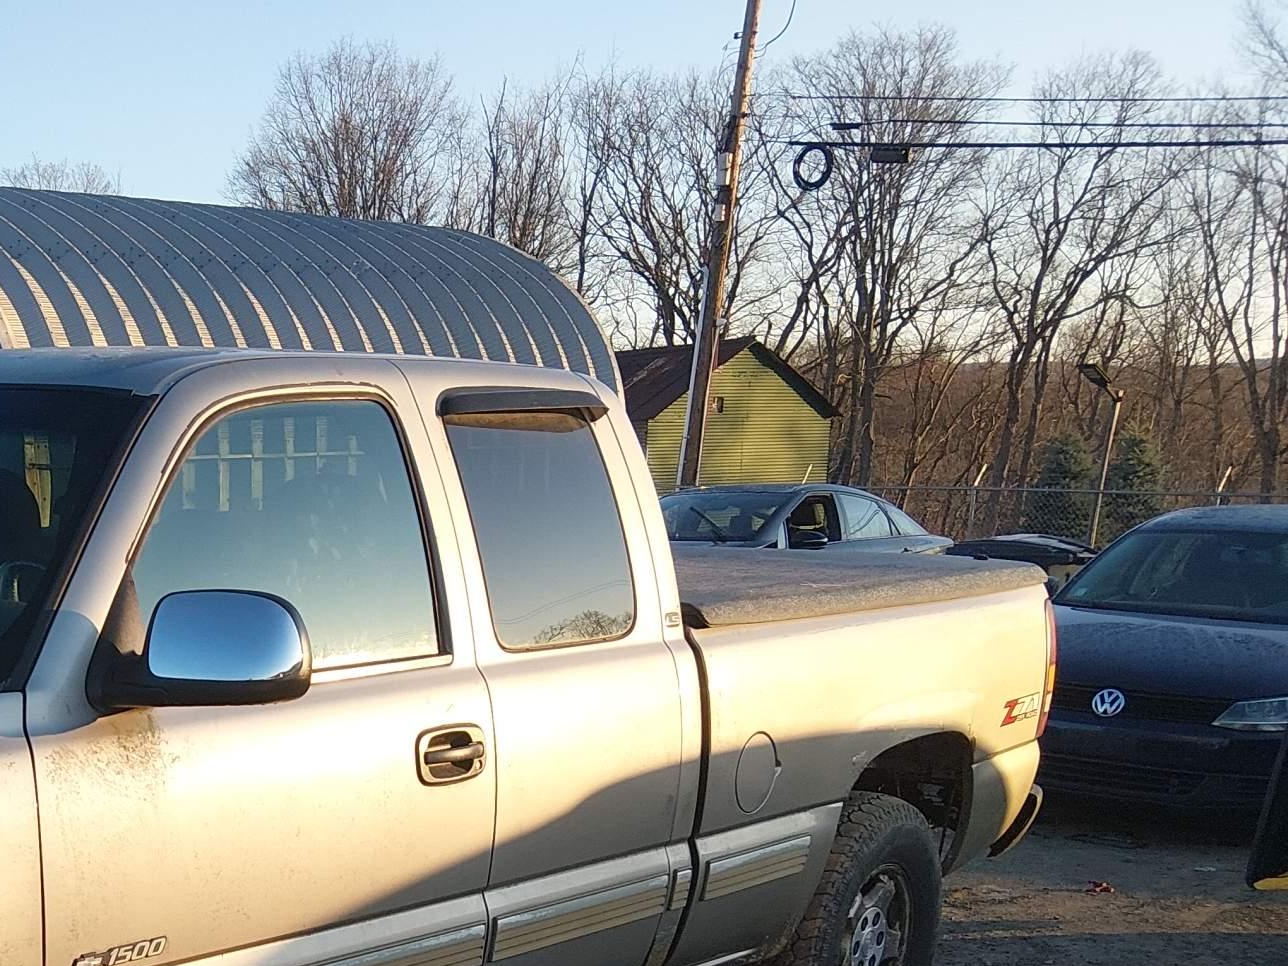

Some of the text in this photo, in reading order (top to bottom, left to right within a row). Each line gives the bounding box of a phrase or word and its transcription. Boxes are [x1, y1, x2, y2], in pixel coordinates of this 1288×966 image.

[1000, 691, 1040, 727] Z71
[1093, 689, 1124, 716] VW
[108, 936, 167, 966] 1500
